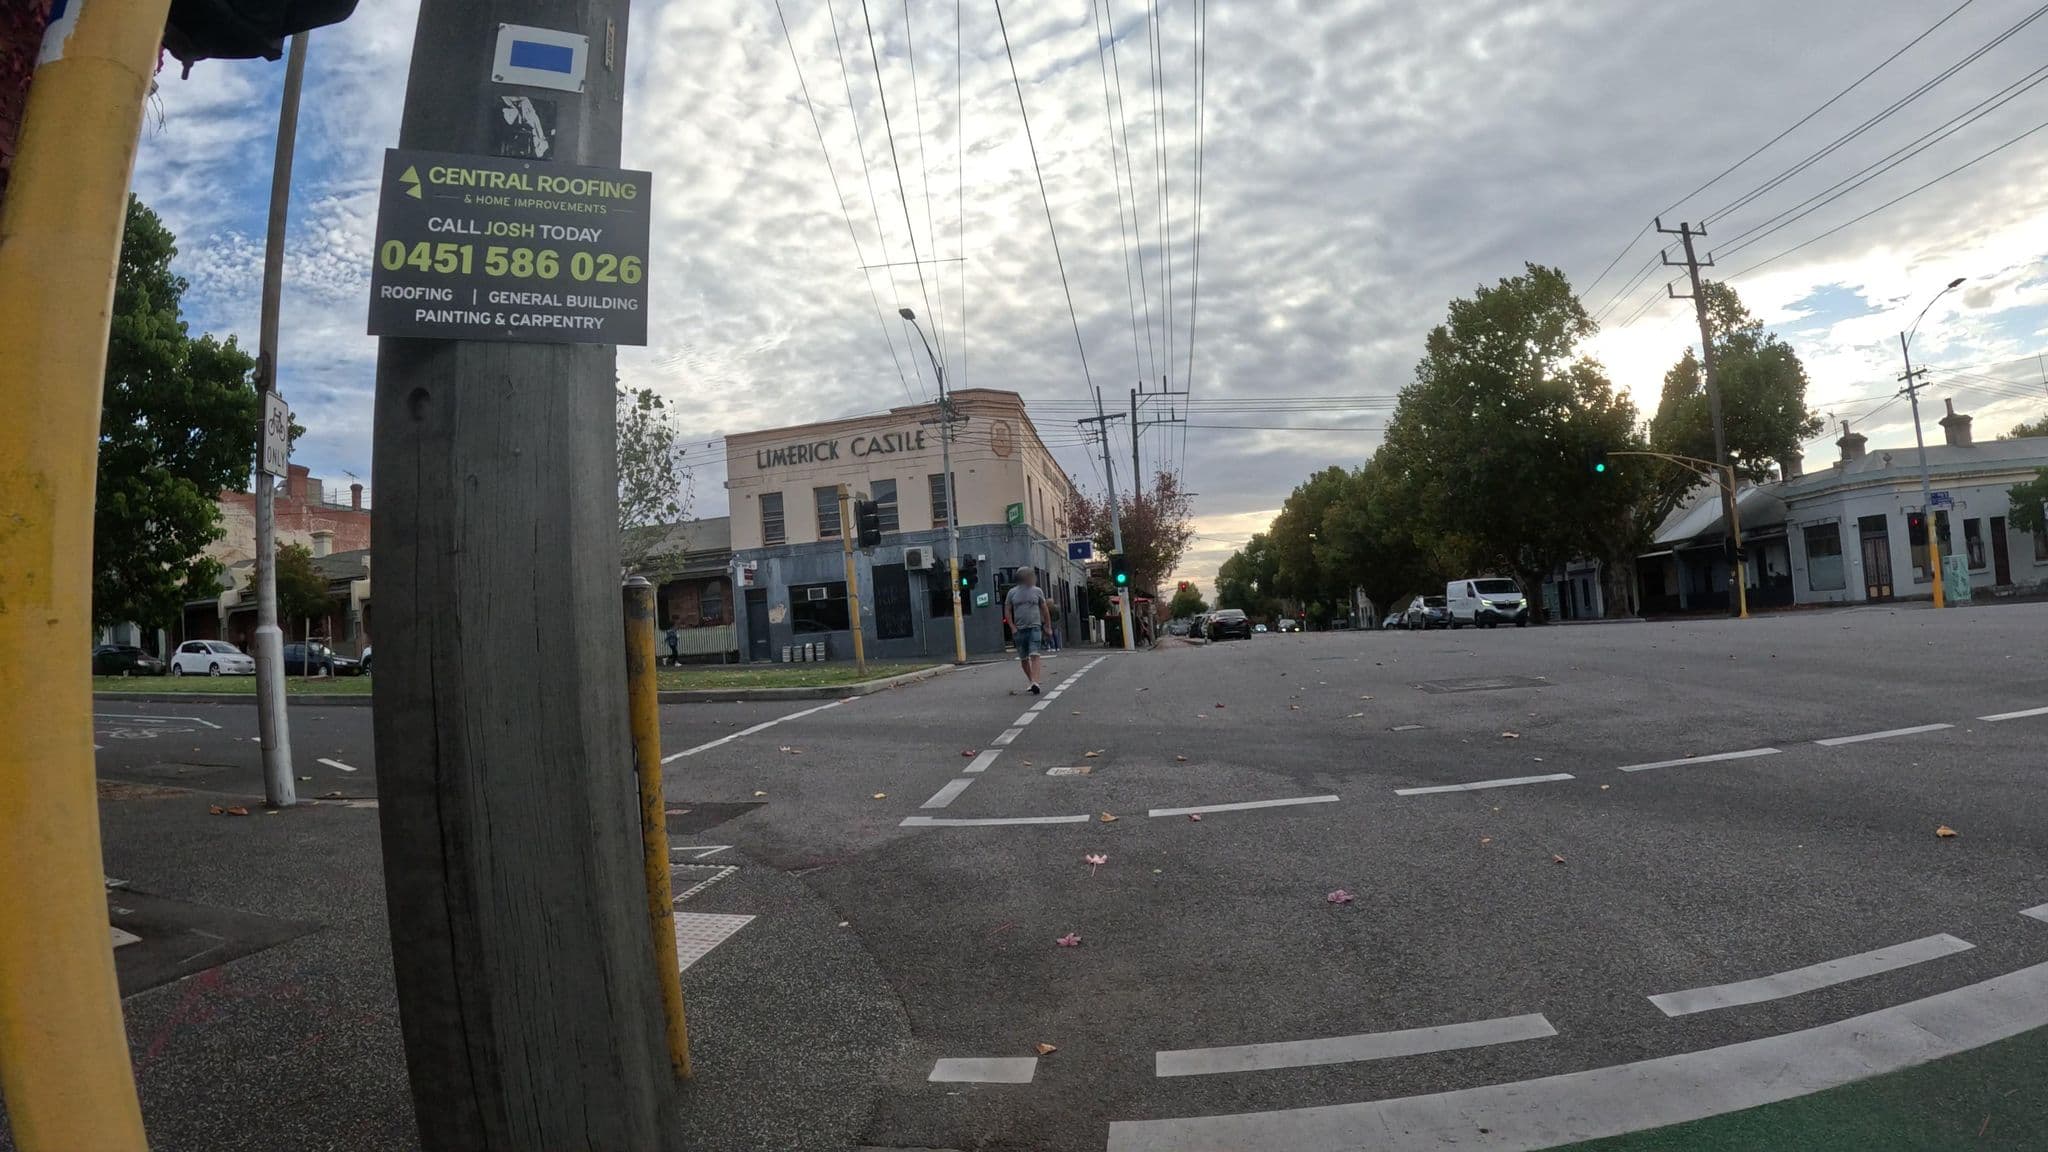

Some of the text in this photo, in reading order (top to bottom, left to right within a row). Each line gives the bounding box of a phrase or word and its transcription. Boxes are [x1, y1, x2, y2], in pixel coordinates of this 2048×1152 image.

[428, 166, 637, 200] CENTRAL ROOFING
[464, 194, 607, 214] & HOME IMPROVEMENTS
[428, 217, 602, 242] CALL JOSH TODAY
[381, 239, 642, 284] 0451 586 026
[380, 285, 639, 311] ROOFING GENERAL BUILDING
[415, 309, 605, 330] PAINTING & CARPENTRY
[266, 446, 286, 470] ONLY
[757, 429, 926, 470] LIMERICK CASTLE
